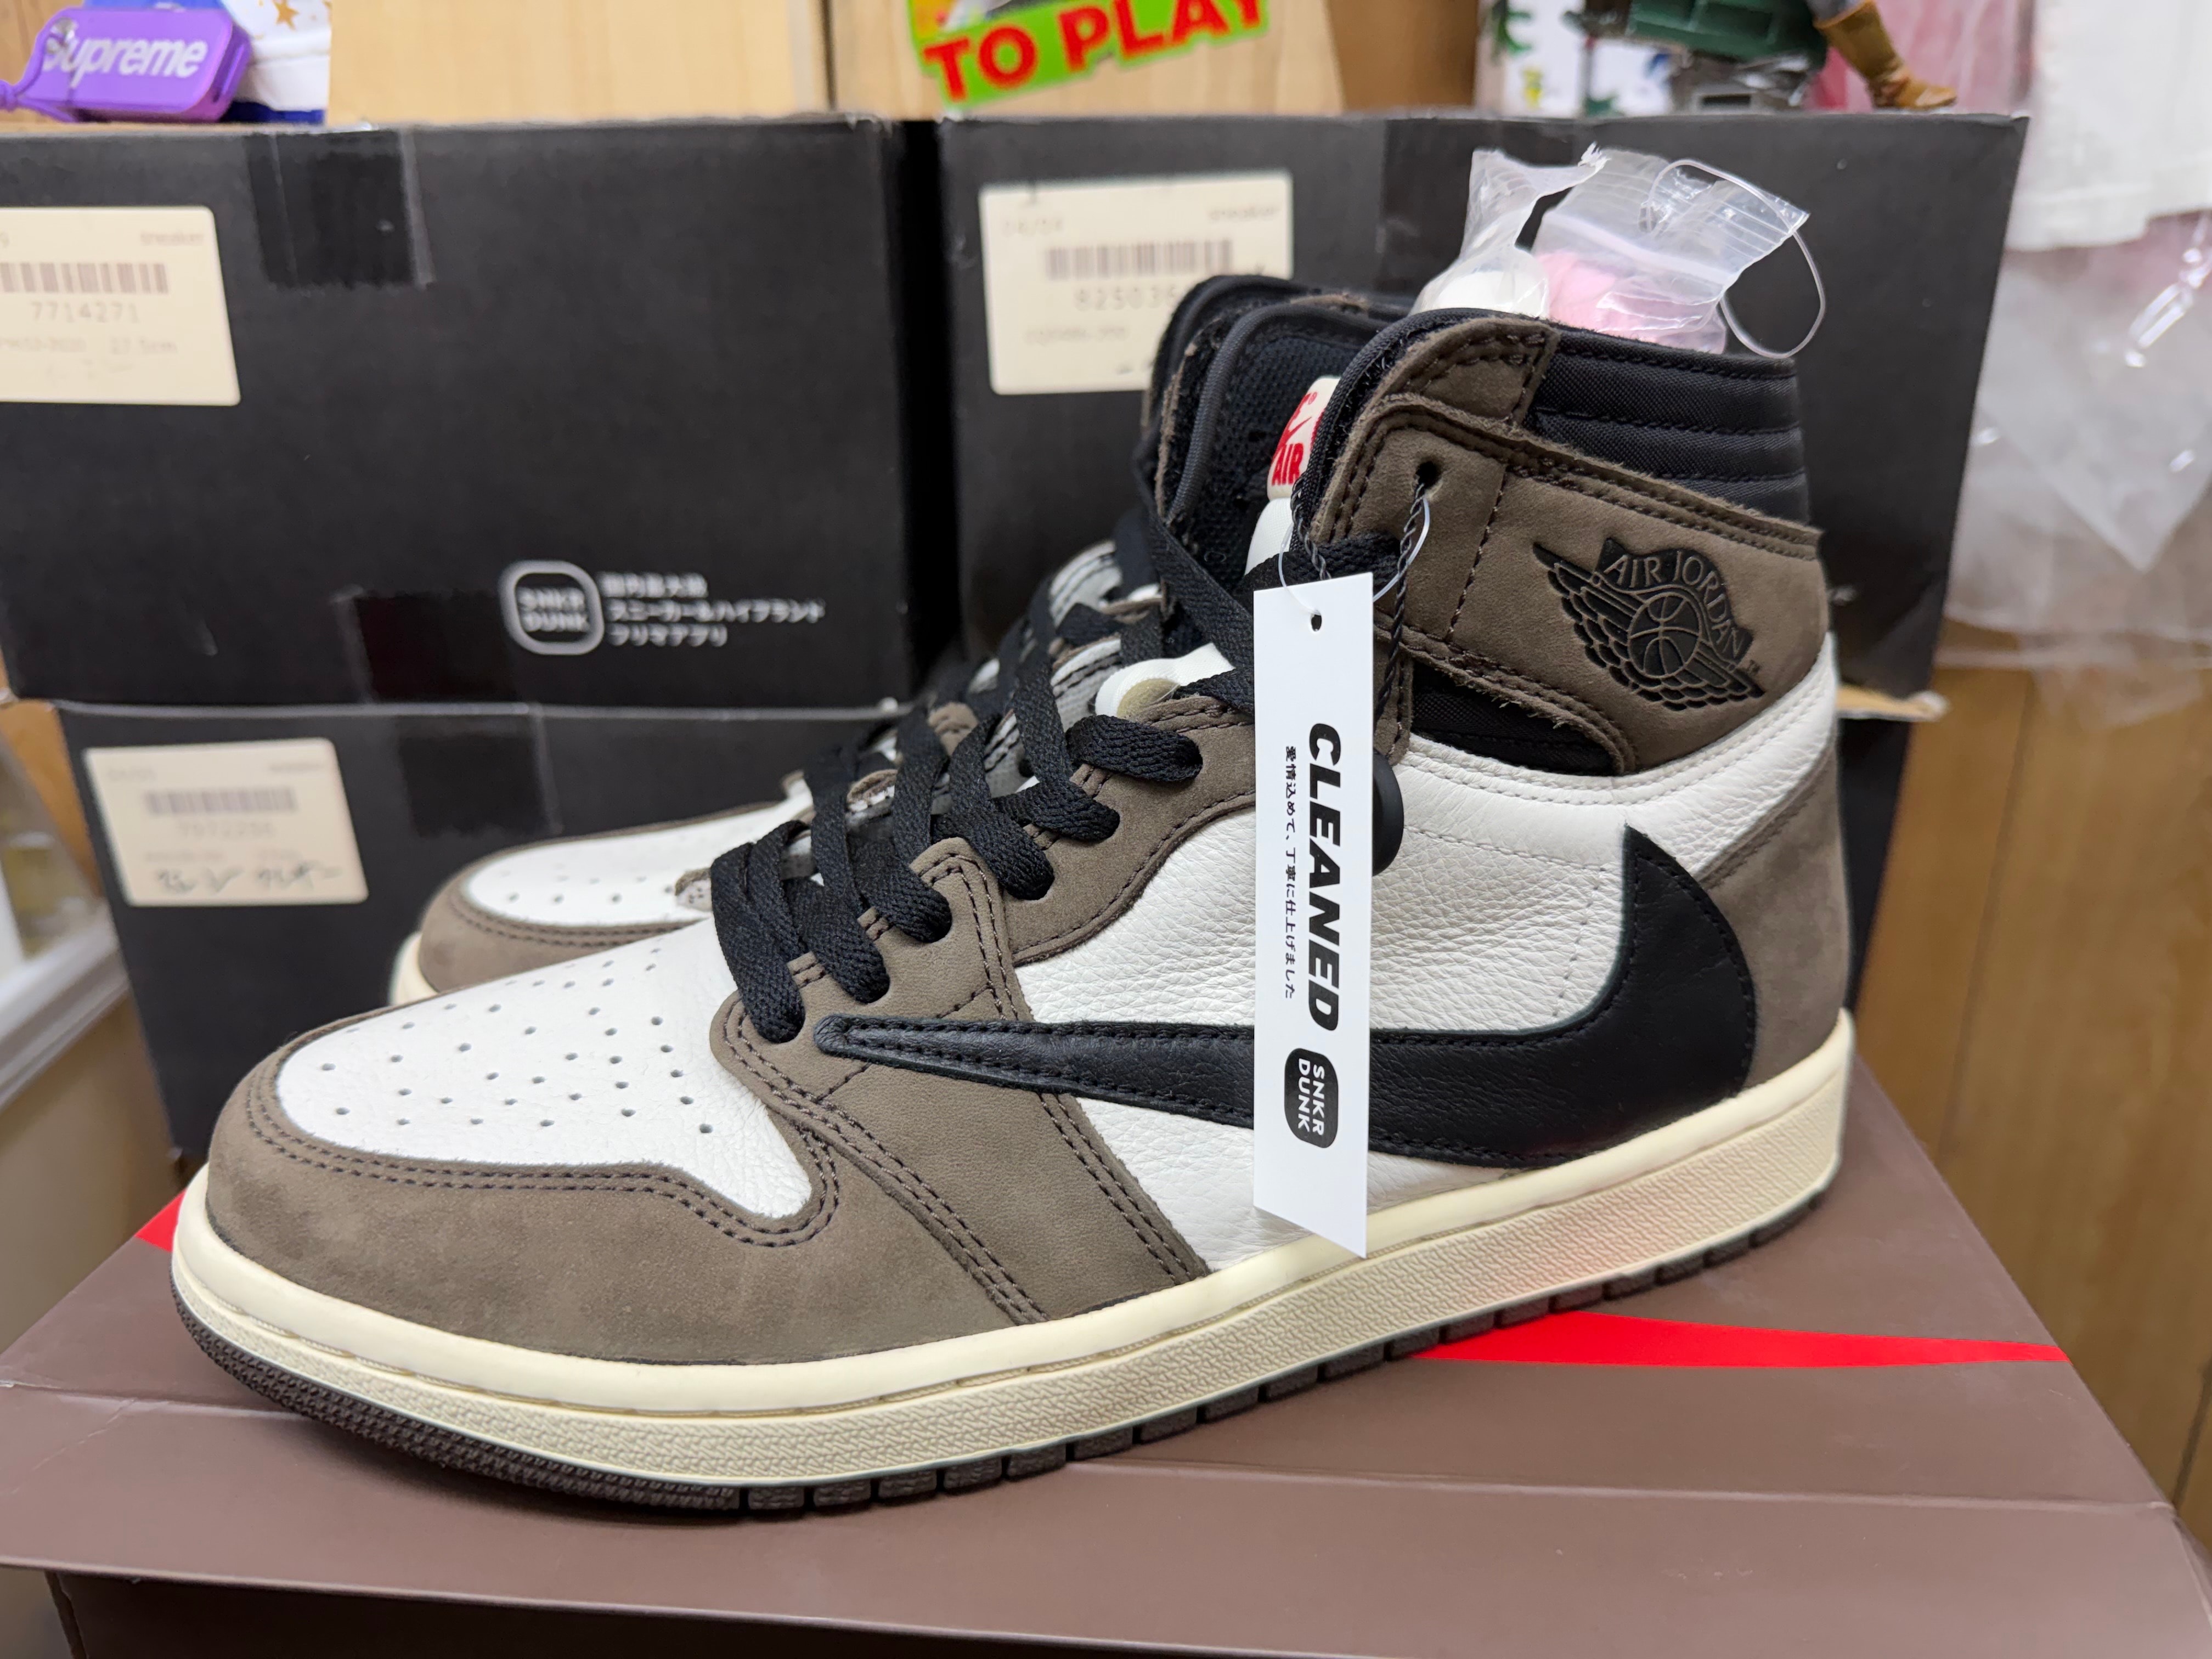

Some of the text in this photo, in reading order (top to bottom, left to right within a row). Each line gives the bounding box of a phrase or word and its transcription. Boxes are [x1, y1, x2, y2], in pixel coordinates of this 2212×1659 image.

[923, 26, 1039, 103] TO
[31, 301, 140, 323] 7714271
[1271, 443, 1304, 486] AIR
[1604, 550, 1745, 656] AIR JORDAN
[1285, 746, 1297, 999] 愛情込めて、丁寧に仕上げました
[1308, 723, 1341, 1031] CLEANED
[1298, 1058, 1311, 1133] DUNK
[1313, 1064, 1325, 1136] SNKR
